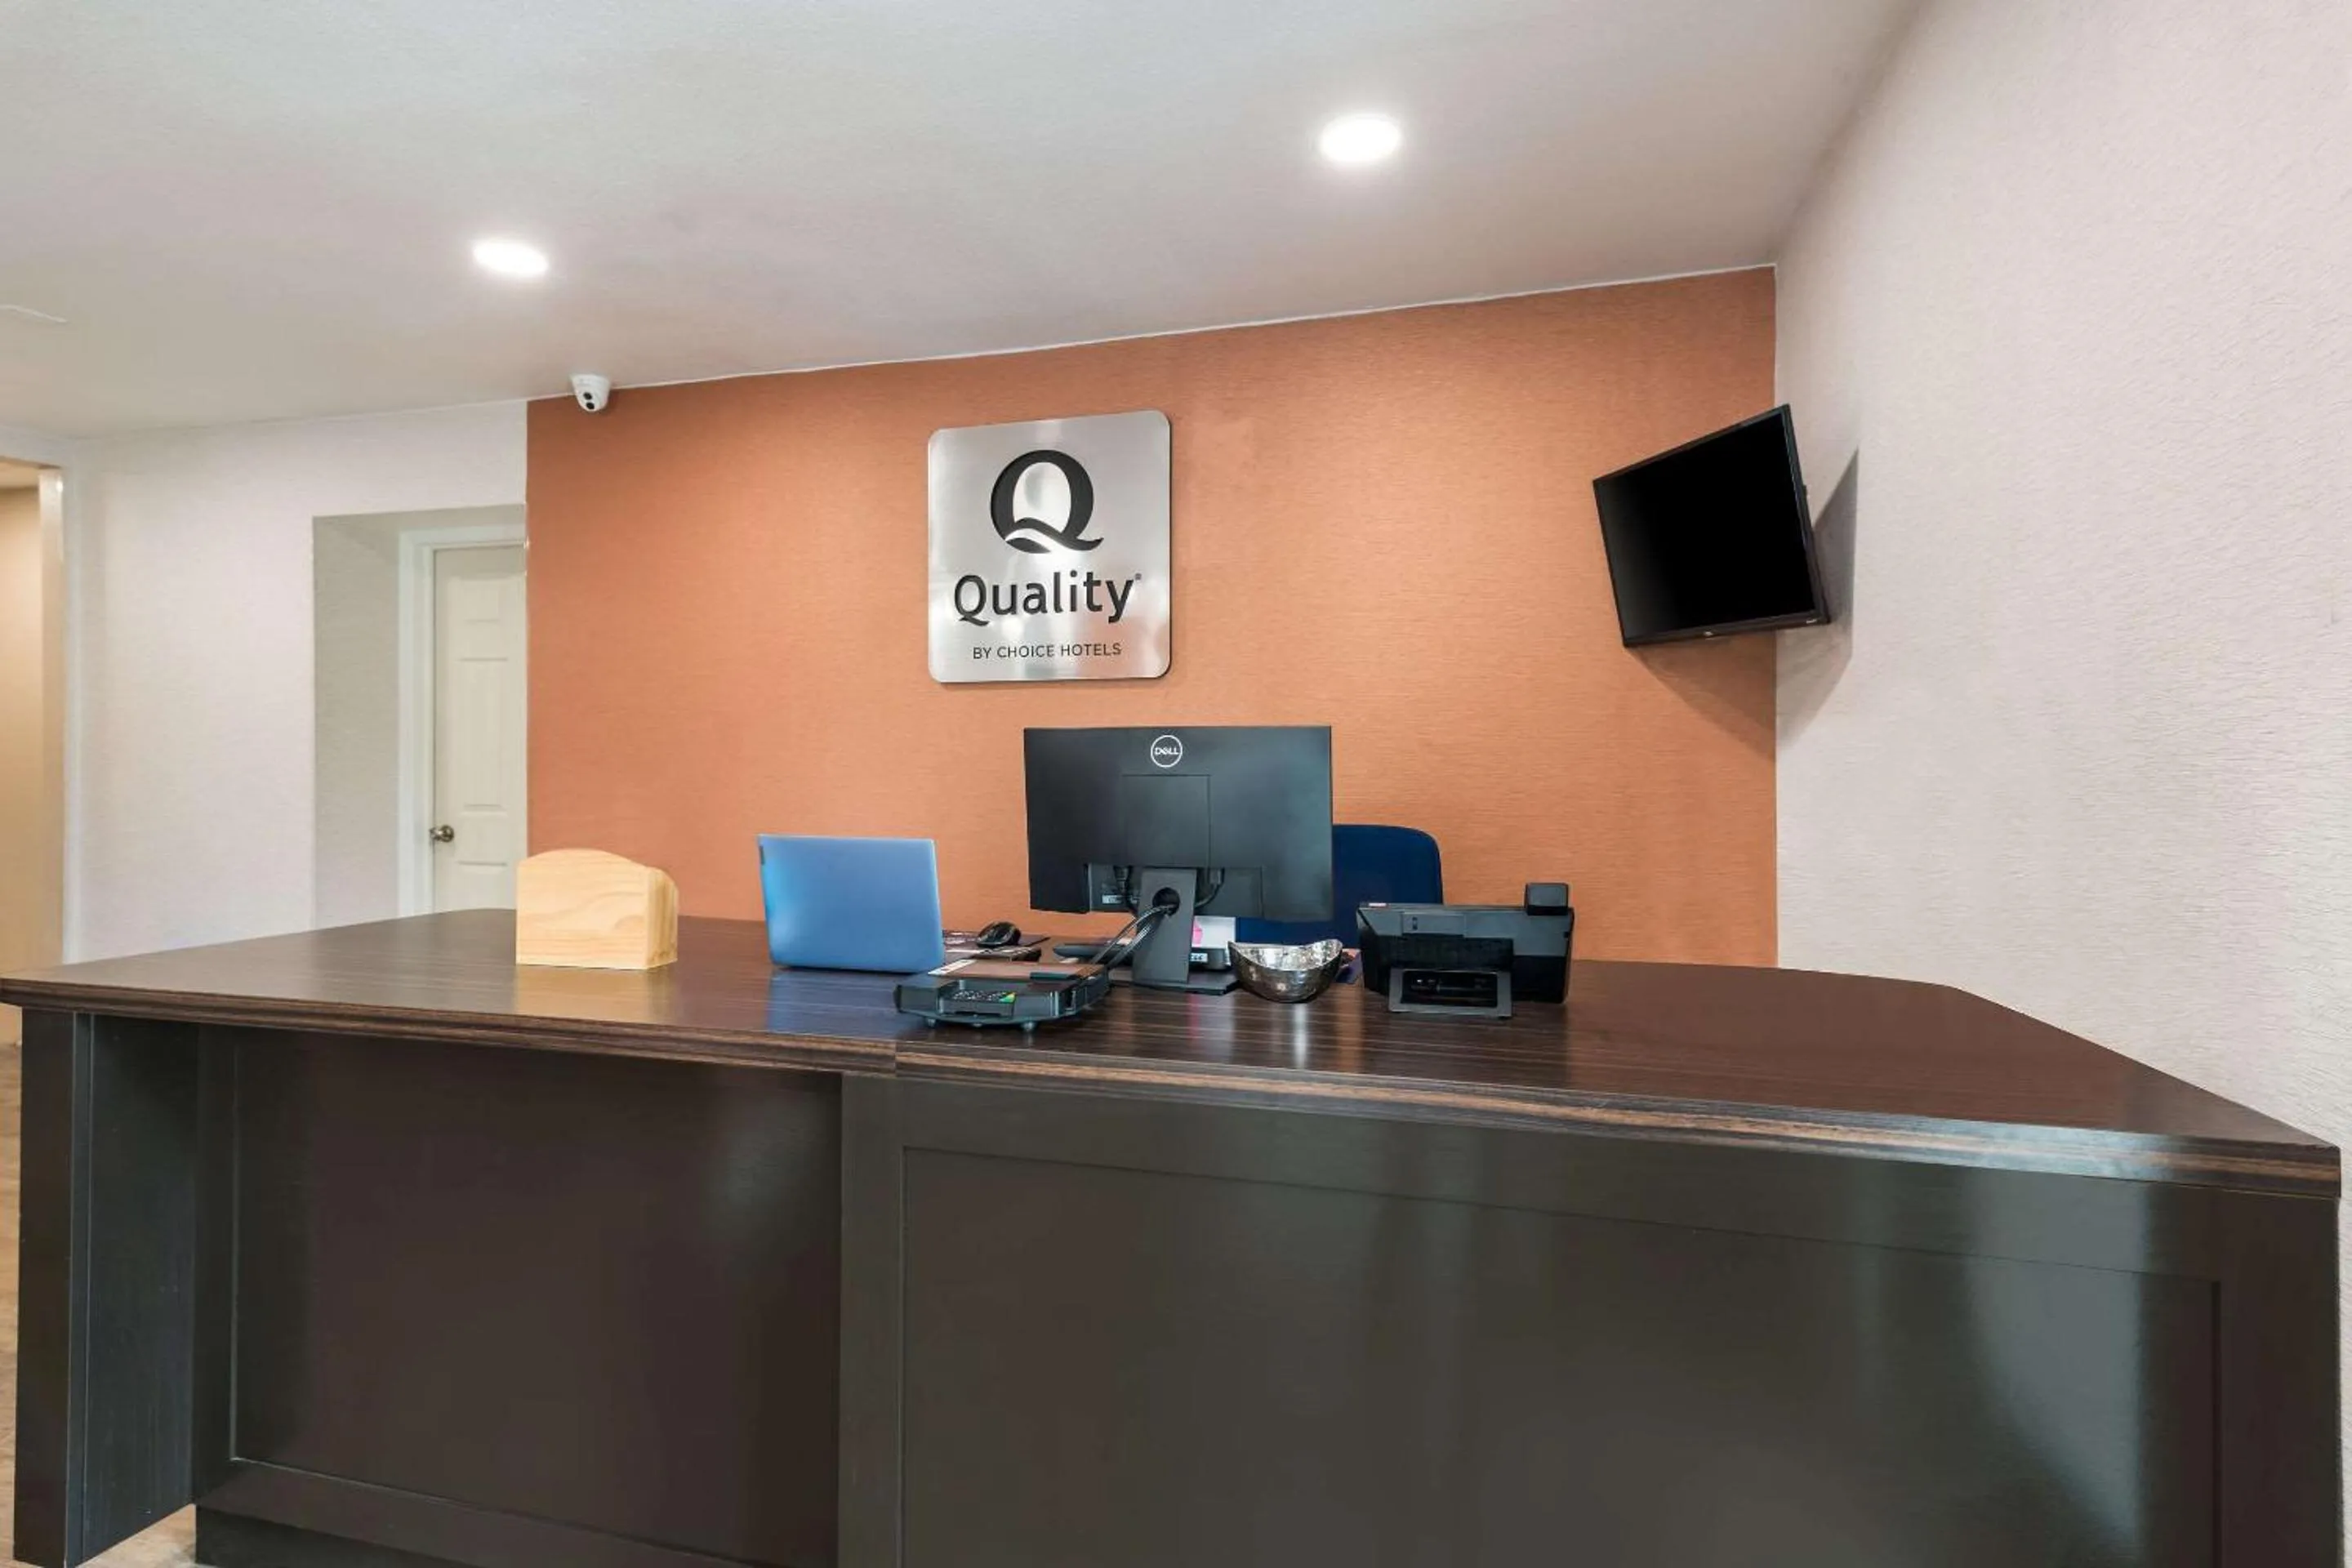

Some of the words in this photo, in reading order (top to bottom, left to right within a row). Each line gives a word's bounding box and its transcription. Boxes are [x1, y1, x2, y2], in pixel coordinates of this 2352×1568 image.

[991, 449, 1104, 554] Q
[954, 570, 1134, 627] Quality
[973, 647, 991, 659] BY
[996, 644, 1054, 658] CHOICE
[1061, 642, 1122, 657] HOTELS
[1155, 746, 1179, 755] DELL
